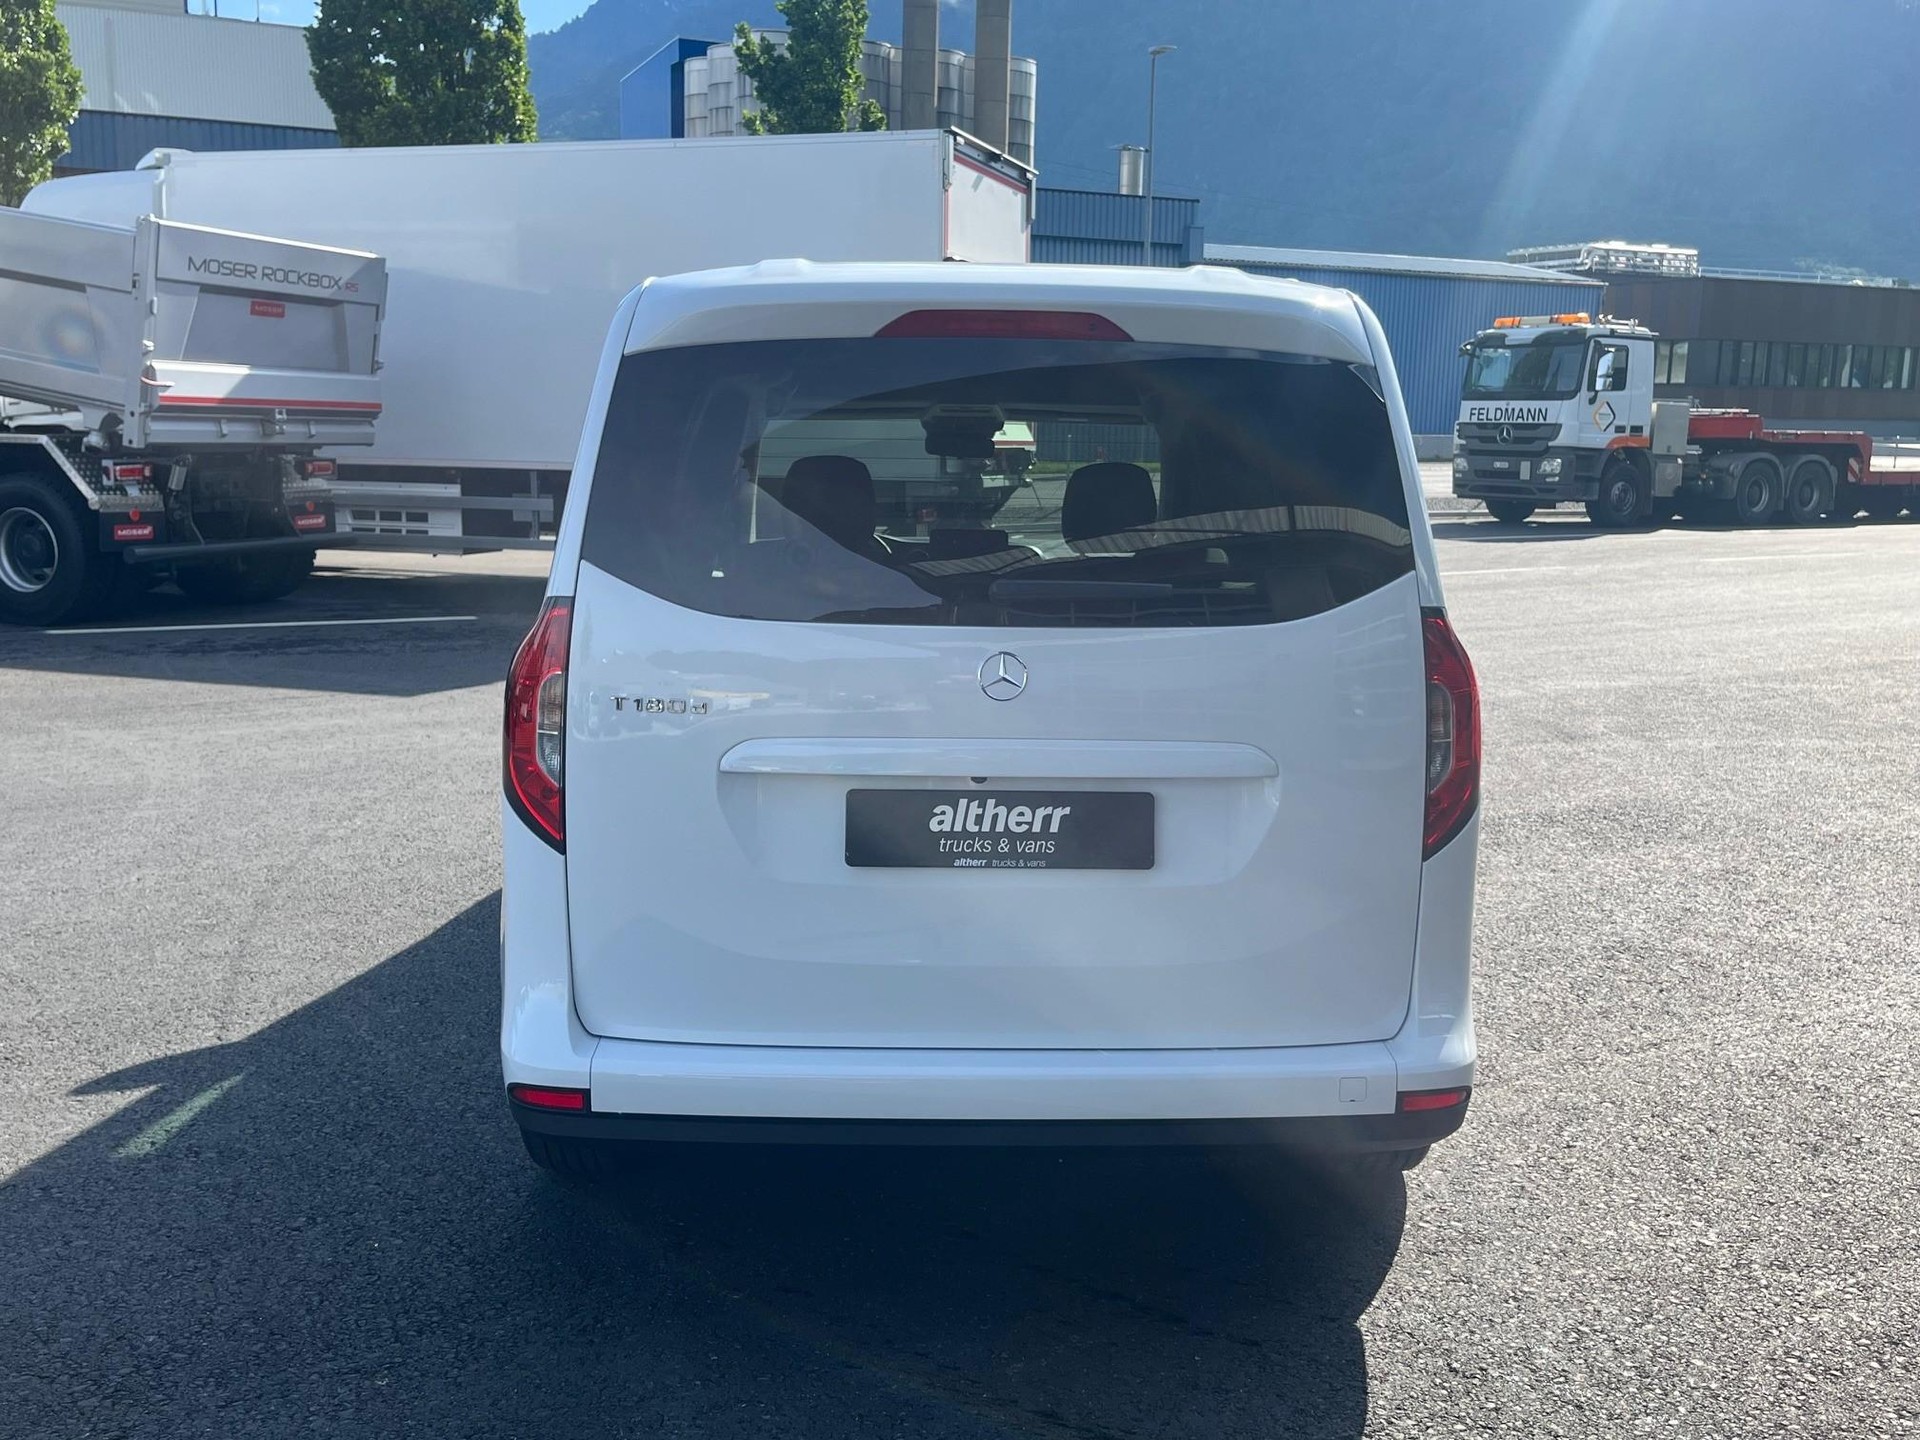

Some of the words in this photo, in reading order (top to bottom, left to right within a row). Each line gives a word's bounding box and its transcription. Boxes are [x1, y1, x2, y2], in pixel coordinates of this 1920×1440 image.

[188, 256, 258, 279] MOSER
[262, 266, 343, 290] ROCKBOX
[1469, 407, 1548, 422] FELDMANN
[117, 527, 149, 536] MOSER
[929, 798, 1071, 833] altherr
[940, 837, 992, 853] trucks
[997, 838, 1010, 853] &
[1017, 840, 1055, 853] vans
[954, 858, 987, 867] altherr
[992, 858, 1016, 867] trucks
